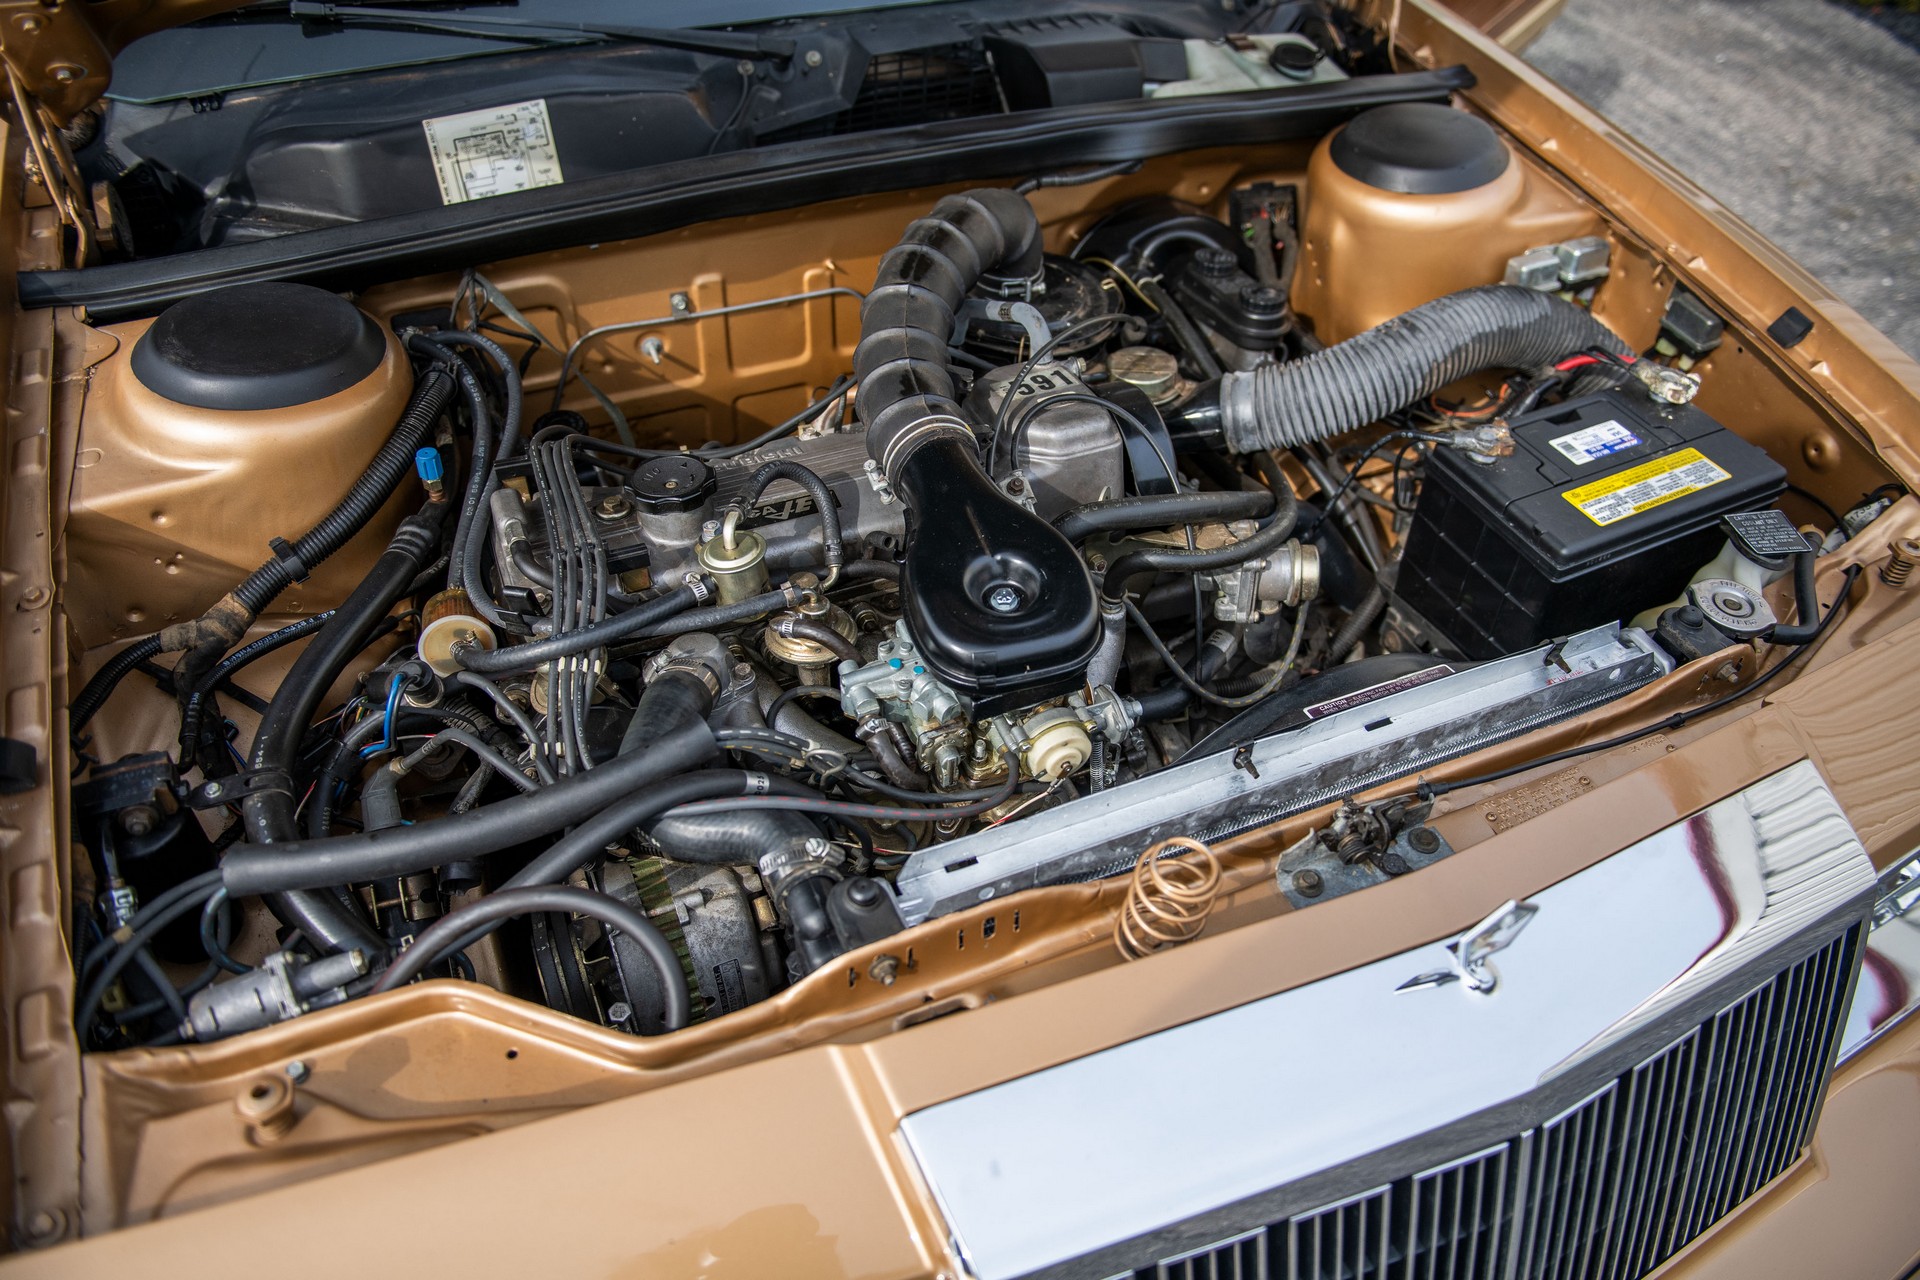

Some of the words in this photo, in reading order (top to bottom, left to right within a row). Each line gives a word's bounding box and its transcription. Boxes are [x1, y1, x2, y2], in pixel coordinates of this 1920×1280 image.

[1009, 370, 1073, 395] 591
[1320, 699, 1346, 711] CAUTION
[1352, 690, 1375, 700] ELECTRIC
[1349, 696, 1370, 706] IGNITION
[1370, 690, 1389, 698] SWITCH
